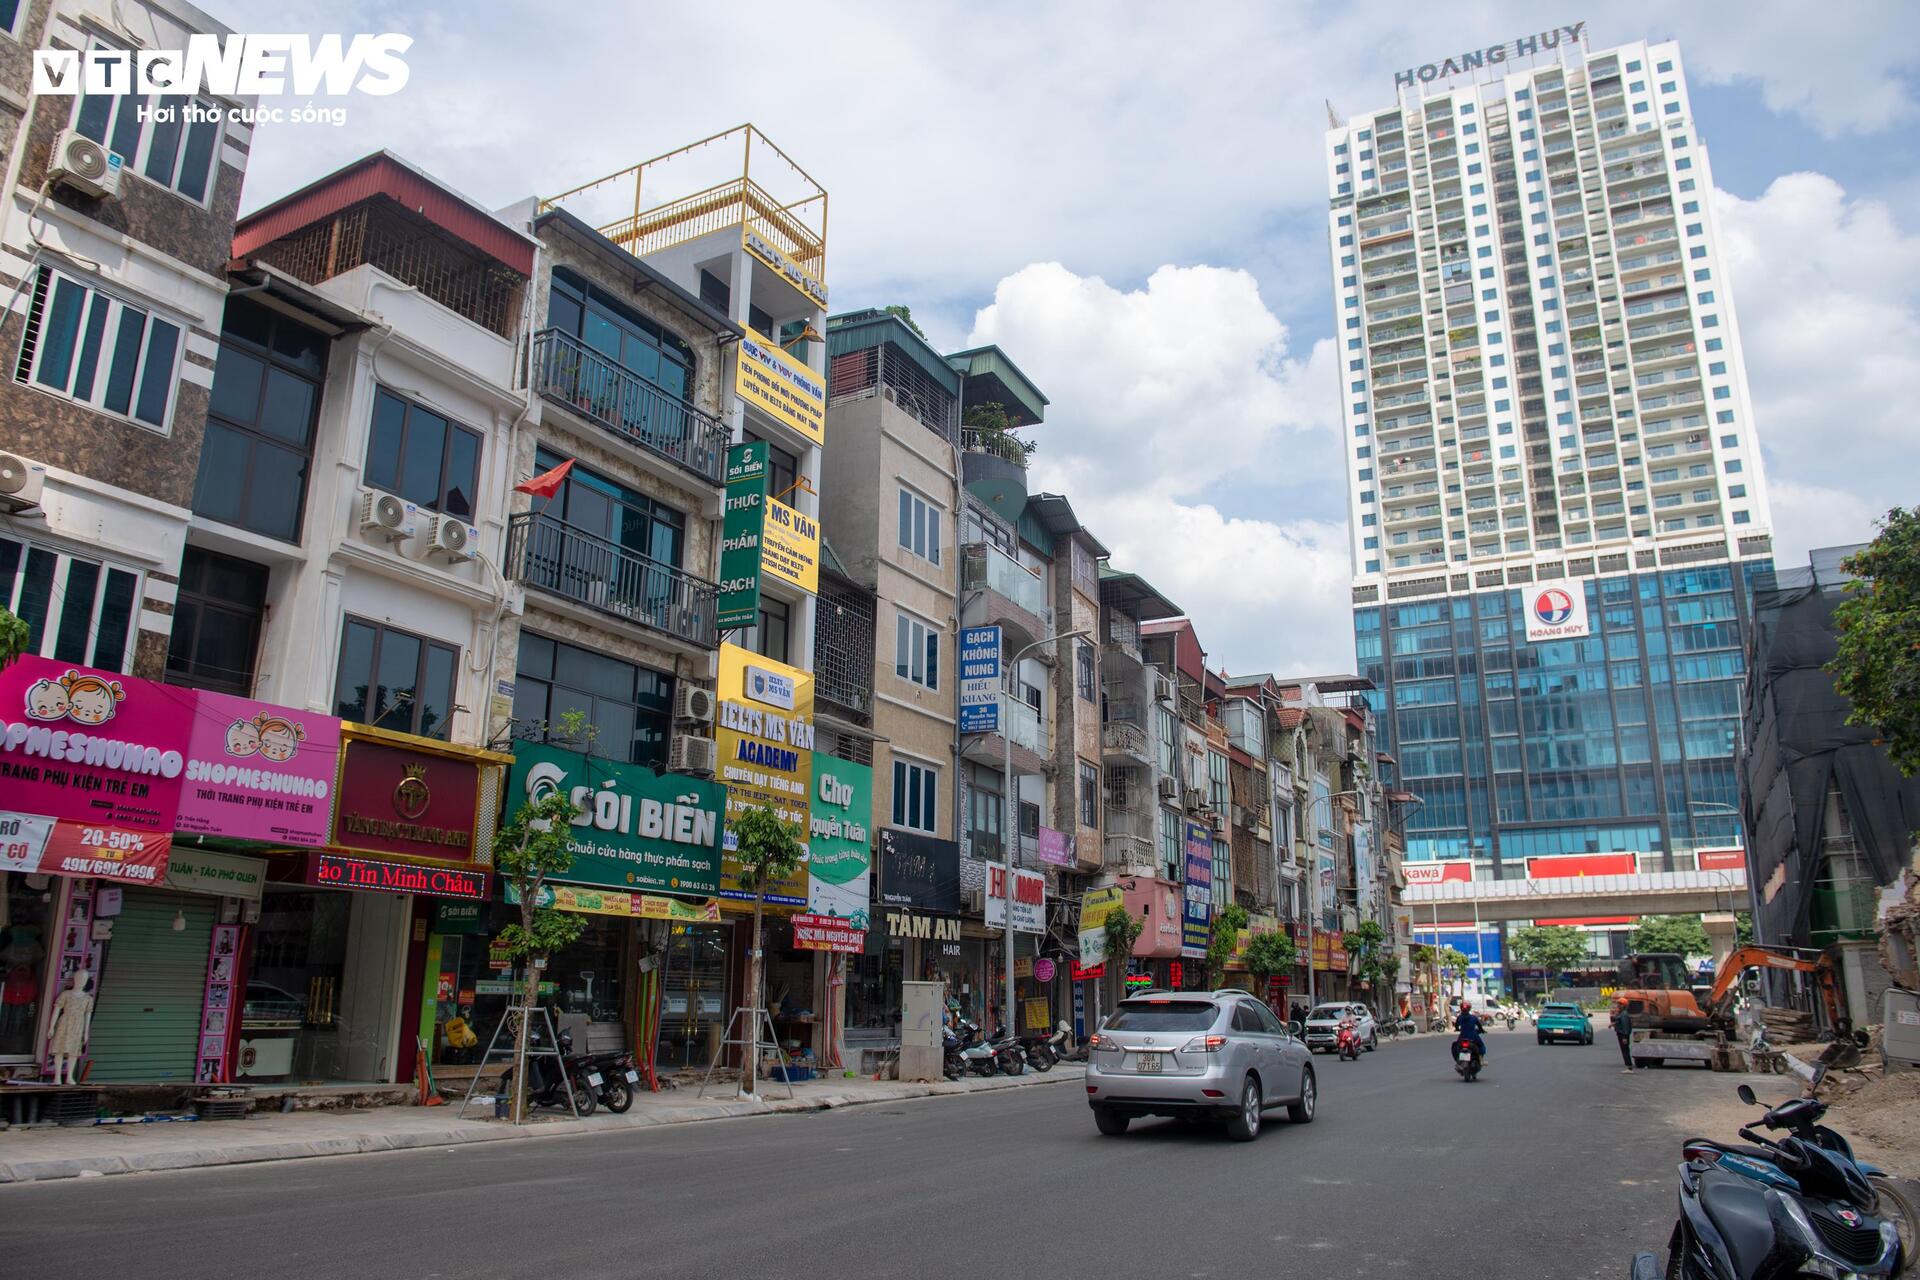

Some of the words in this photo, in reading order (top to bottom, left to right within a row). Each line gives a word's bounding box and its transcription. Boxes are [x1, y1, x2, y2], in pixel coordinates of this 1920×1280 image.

[1394, 44, 1506, 91] HOANG
[1516, 21, 1586, 57] HUY
[726, 493, 760, 512] THỰC
[771, 503, 790, 527] MS
[794, 514, 815, 541] VÂN
[722, 529, 758, 552] PHẨM
[720, 576, 755, 596] SẠCH
[966, 631, 994, 646] GẠCH
[1530, 627, 1562, 638] HOANG
[1564, 625, 1584, 634] HUY
[962, 646, 998, 661] KHÔNG
[965, 663, 994, 676] NUNG
[768, 684, 778, 694] MS
[778, 685, 791, 699] VÂN
[962, 693, 996, 703] KHANG
[720, 702, 762, 735] IELTS
[765, 713, 786, 743] MS
[789, 715, 815, 751] VÂN
[737, 739, 799, 773] ACADEMY
[43, 769, 70, 789] PHỤ
[72, 771, 102, 793] KIỆN
[106, 776, 130, 796] TRẺ
[131, 783, 149, 799] EM
[723, 766, 753, 784] CHUYÊN
[754, 774, 768, 788] DẠY
[770, 775, 789, 791] TIẾNG
[790, 781, 805, 795] ANH
[819, 773, 854, 811] Chợ
[197, 787, 215, 801] THỜI
[218, 791, 245, 805] TRANG
[246, 795, 263, 809] PHỤ
[264, 797, 283, 812] KIỆN
[285, 800, 299, 813] TRẺ
[301, 803, 313, 814] EM
[569, 779, 632, 834] SÓI
[638, 793, 717, 847] BIỂN
[81, 828, 145, 851] 20-50%
[843, 820, 866, 843] Tuân
[566, 839, 596, 855] Chuỗi
[598, 844, 616, 858] cửa
[618, 848, 642, 864] hàng
[644, 849, 664, 866] thực
[666, 852, 690, 868] phẩm
[692, 857, 711, 871] sạch
[61, 857, 157, 880] 49K/69K/199K
[346, 862, 378, 885] Tín
[382, 866, 427, 890] Minh
[432, 872, 477, 896] Châu,
[886, 906, 931, 938] TÂM
[934, 918, 961, 941] AN
[943, 944, 961, 956] HAIR
